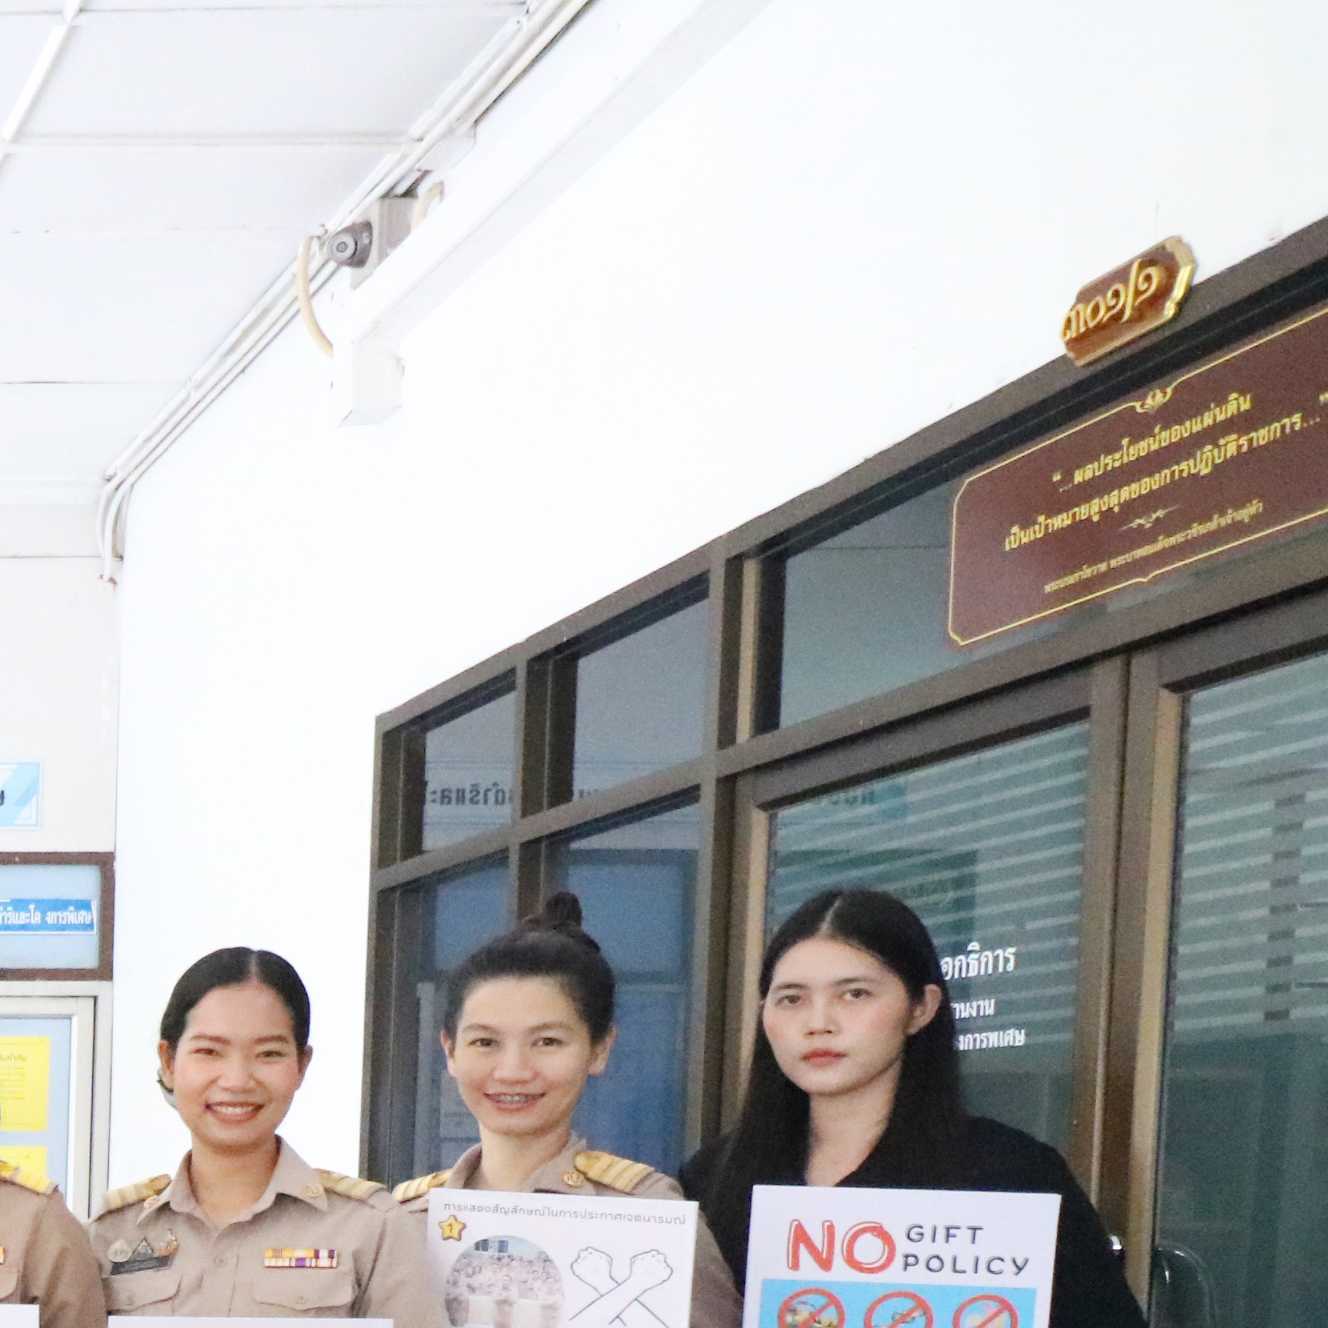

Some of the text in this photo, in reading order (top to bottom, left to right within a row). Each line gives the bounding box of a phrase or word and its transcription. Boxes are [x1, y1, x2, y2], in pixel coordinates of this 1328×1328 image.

[951, 998, 996, 1020] านงาน
[787, 1218, 984, 1274] NO GIFT
[901, 1252, 1030, 1277] POLICY
